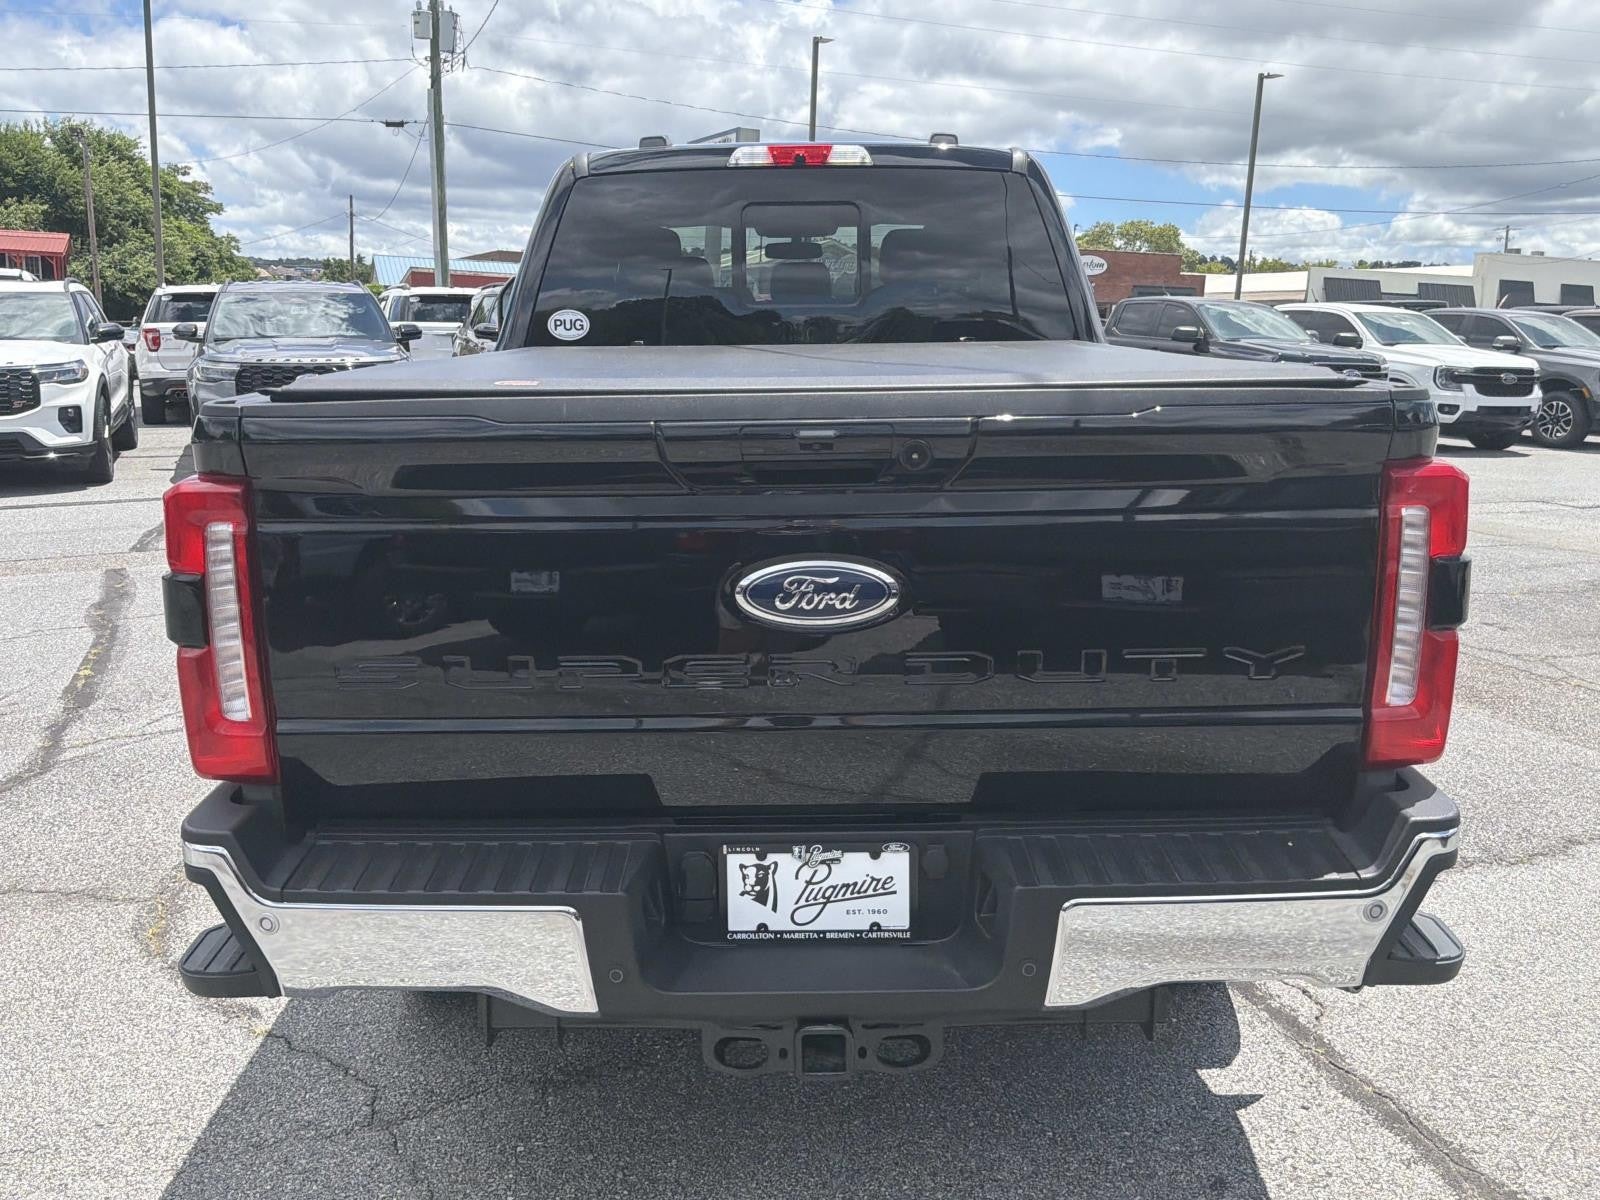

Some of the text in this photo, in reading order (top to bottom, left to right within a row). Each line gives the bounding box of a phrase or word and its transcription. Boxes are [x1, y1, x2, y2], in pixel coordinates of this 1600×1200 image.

[553, 318, 584, 331] PUG
[774, 575, 861, 610] Ford
[336, 645, 1306, 691] SUPER DUTY
[790, 861, 898, 926] Pugmire
[727, 932, 775, 940] CARROLLTON
[826, 931, 855, 939] BREMEN
[862, 931, 911, 939] CARTERSVILLE
